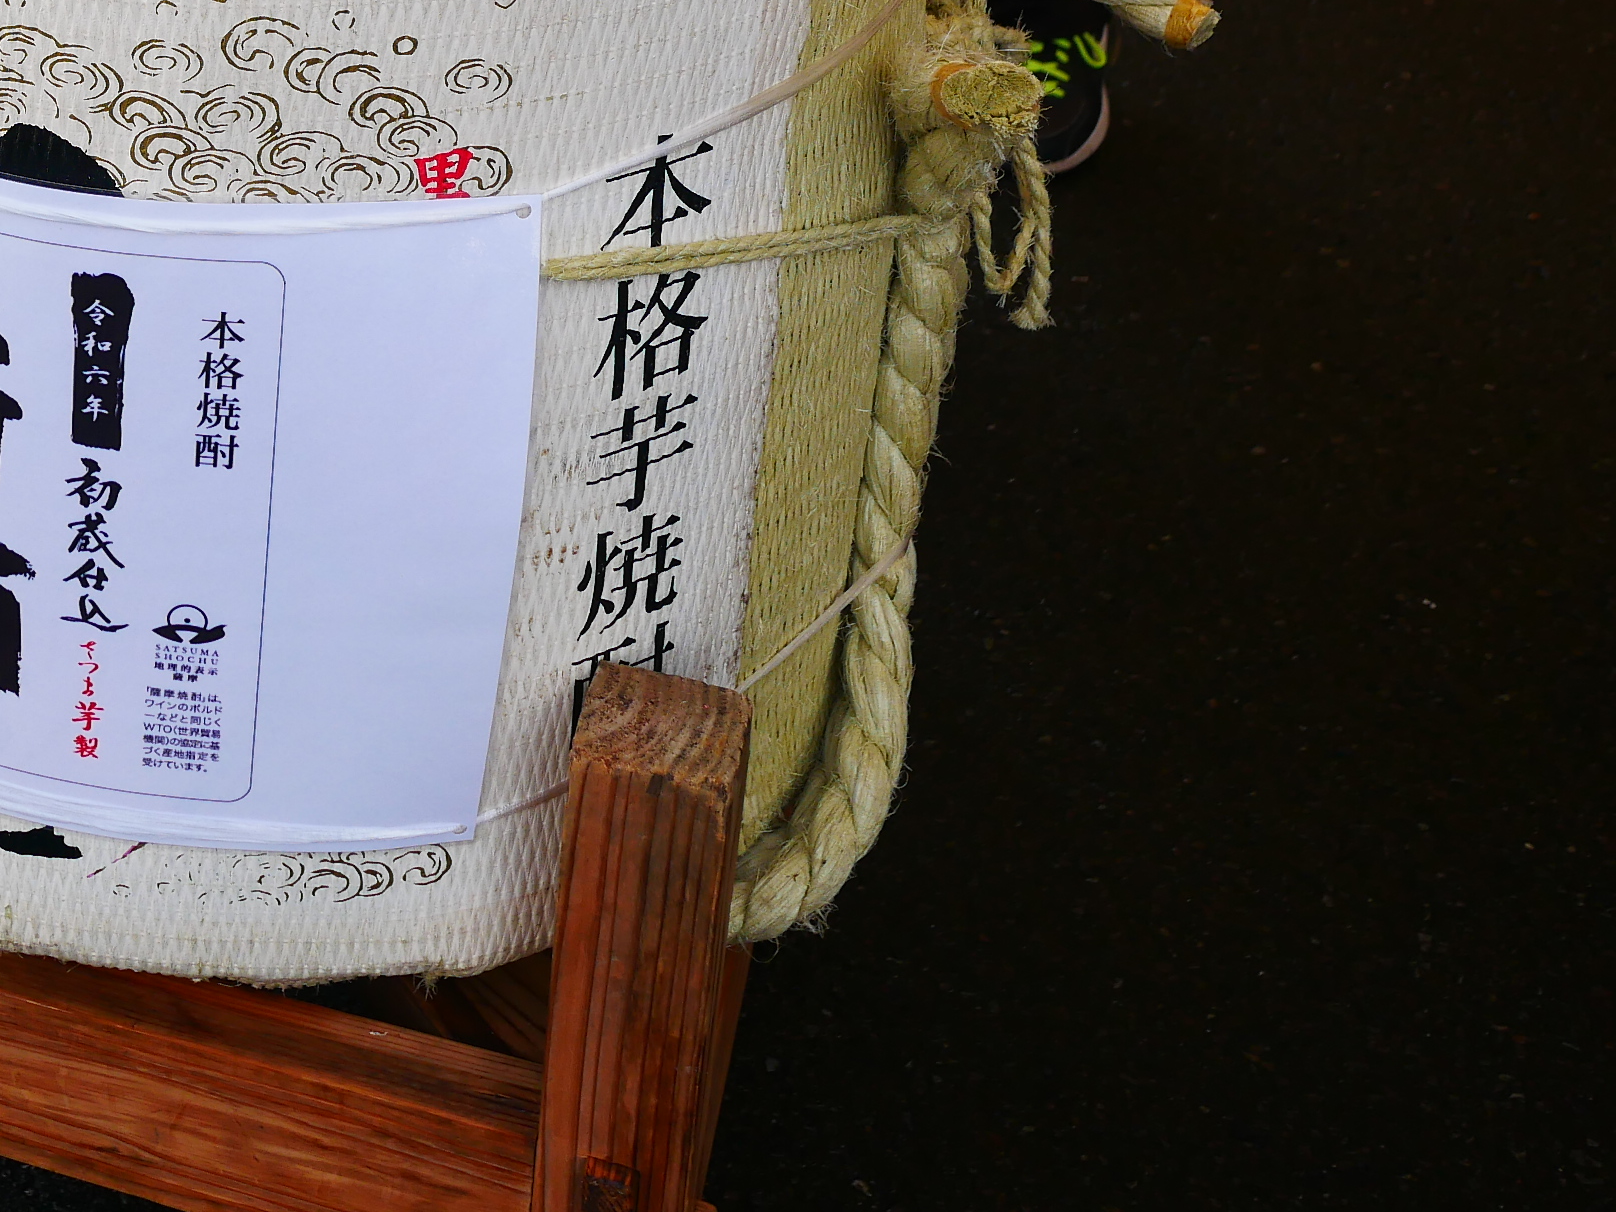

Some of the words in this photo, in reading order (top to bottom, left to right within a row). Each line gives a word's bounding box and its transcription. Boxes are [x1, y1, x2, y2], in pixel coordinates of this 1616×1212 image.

[80, 299, 115, 422] 令和六年
[194, 310, 246, 471] 本格焼酎
[153, 661, 219, 676] 地理的表示
[154, 652, 219, 666] SHOCHU
[155, 643, 219, 658] SATSUMA
[71, 640, 105, 760] さつま芋製
